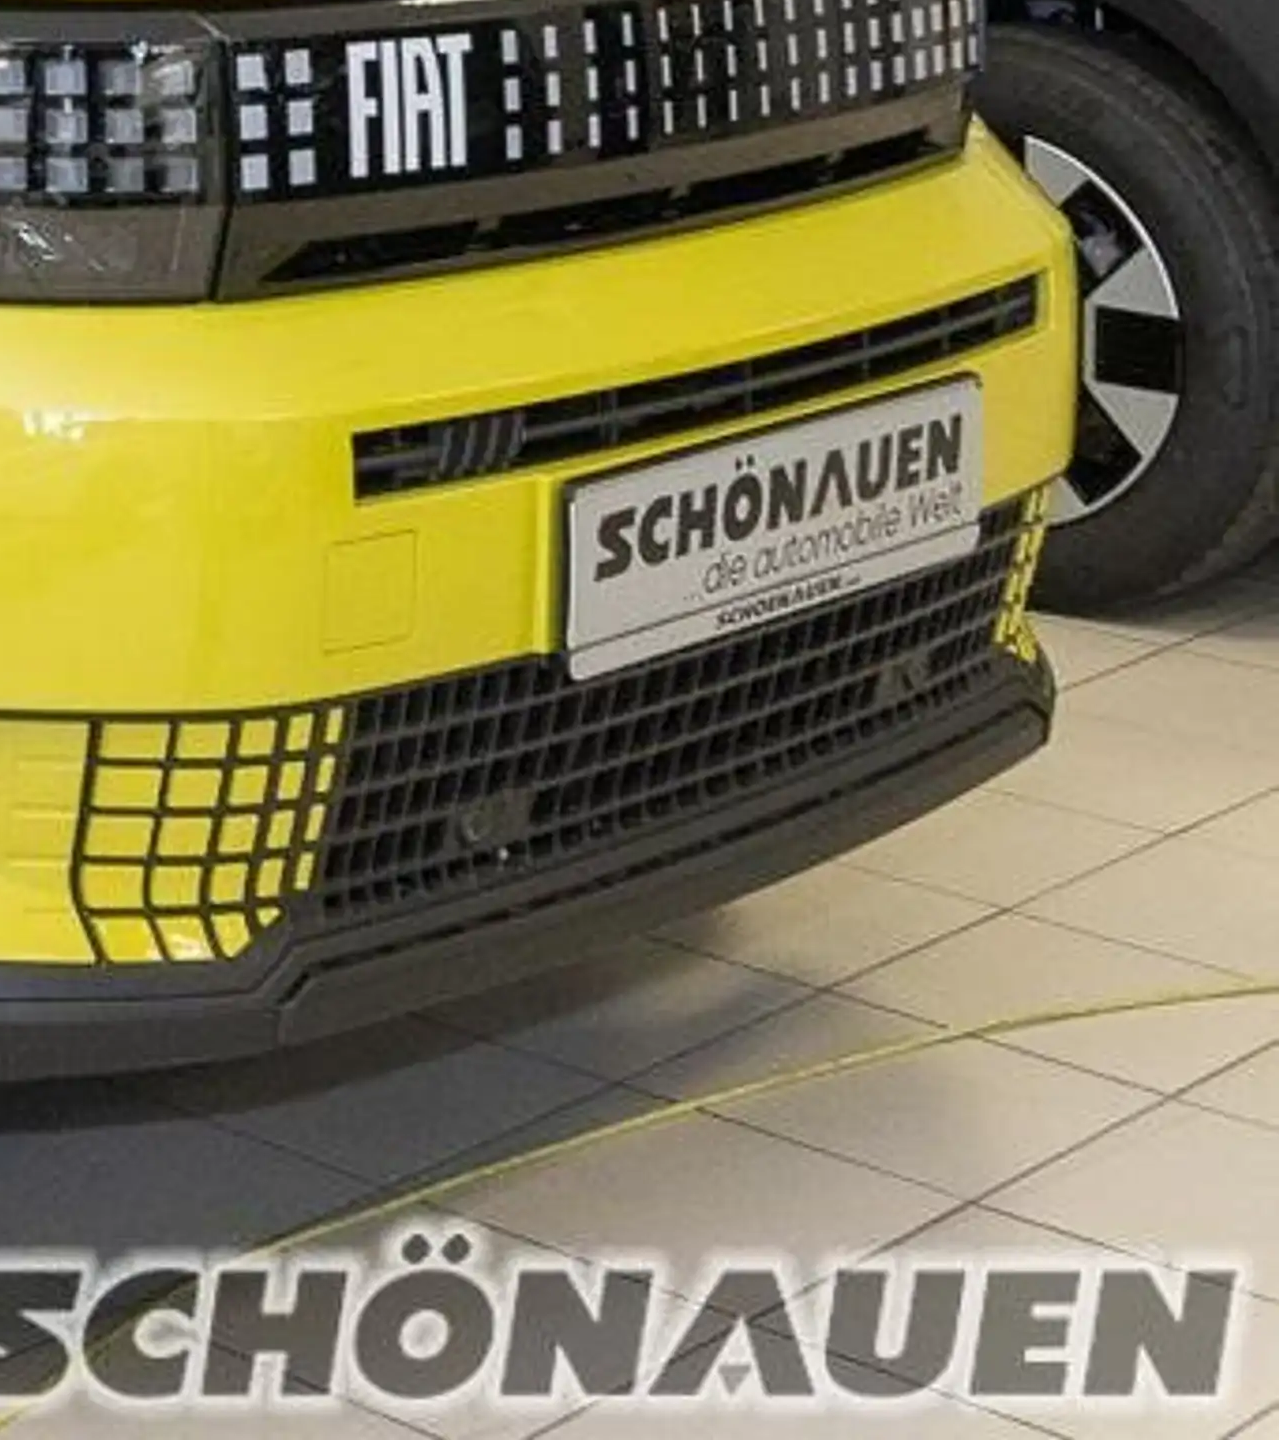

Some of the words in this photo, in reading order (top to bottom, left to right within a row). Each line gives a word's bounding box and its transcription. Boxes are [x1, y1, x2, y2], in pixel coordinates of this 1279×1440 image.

[345, 33, 473, 178] FIAT
[593, 414, 963, 582] SCHÖNAUEN
[753, 502, 901, 579] automobile
[909, 480, 963, 528] Welt
